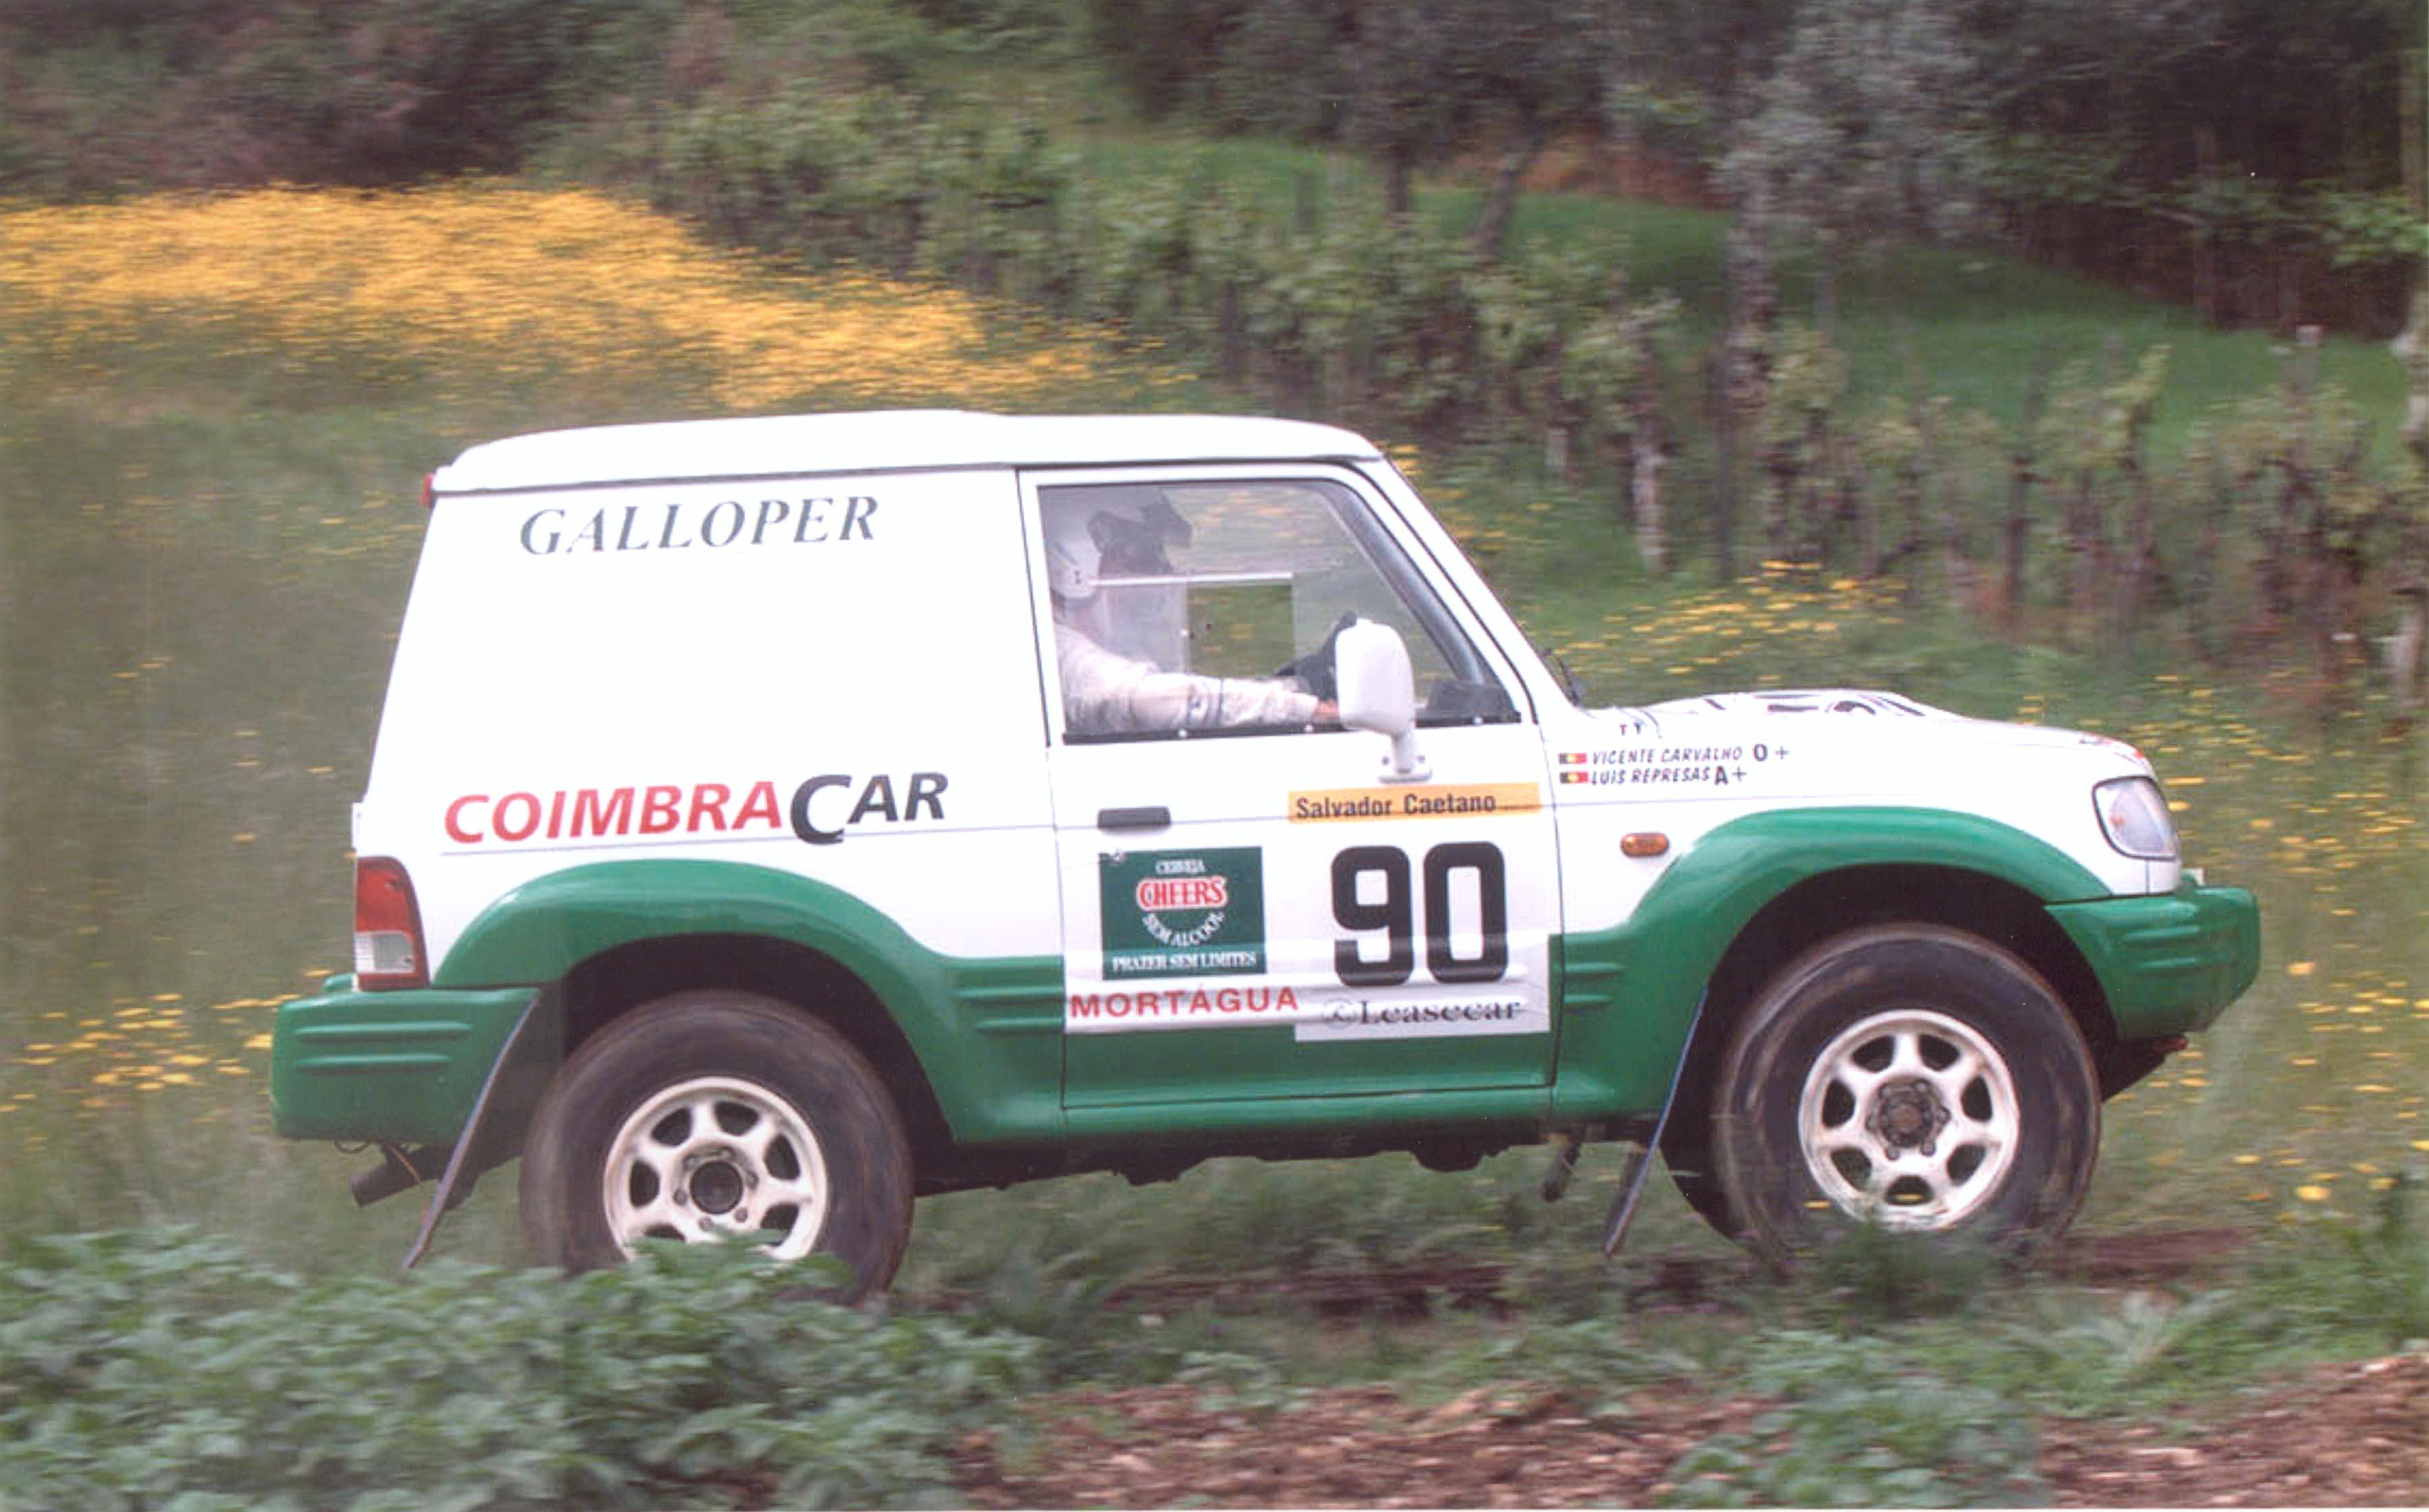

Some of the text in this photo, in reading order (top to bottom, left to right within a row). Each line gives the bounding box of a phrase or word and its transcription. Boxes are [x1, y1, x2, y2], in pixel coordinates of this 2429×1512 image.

[520, 496, 879, 555] GALLOPER
[1592, 748, 1654, 765] VICENTE
[1660, 746, 1743, 763] CARVALHO
[1591, 769, 1626, 786] LUIS
[1631, 766, 1711, 784] REPRESAS
[1296, 792, 1496, 819] Salvador Caetano
[1155, 859, 1206, 874] CERVEJA
[1137, 877, 1226, 909] CHEERS
[1331, 841, 1508, 987] 90
[1142, 911, 1225, 946] SEM ALCOOL
[1113, 952, 1257, 972] PRAZER SEM LIMITES
[1070, 983, 1298, 1018] MORTÁGUA
[1358, 1000, 1521, 1025] Leasecar
